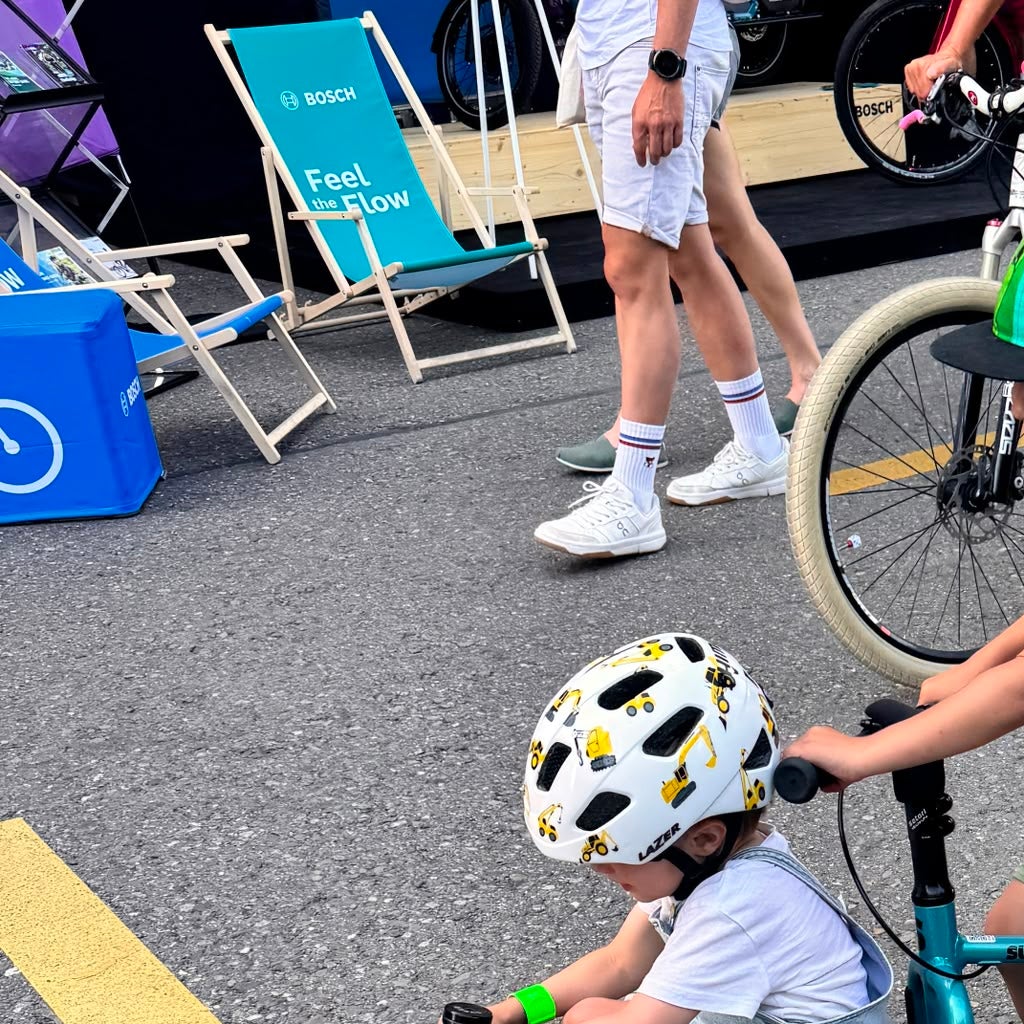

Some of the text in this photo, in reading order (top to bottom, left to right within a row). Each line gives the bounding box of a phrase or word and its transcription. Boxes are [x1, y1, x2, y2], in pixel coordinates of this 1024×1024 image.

[303, 86, 357, 106] BOSCH
[856, 100, 894, 118] BOSCH
[303, 162, 372, 193] Feel
[311, 189, 410, 215] the Flow
[126, 375, 142, 407] BOSCH
[638, 822, 682, 862] LAZER
